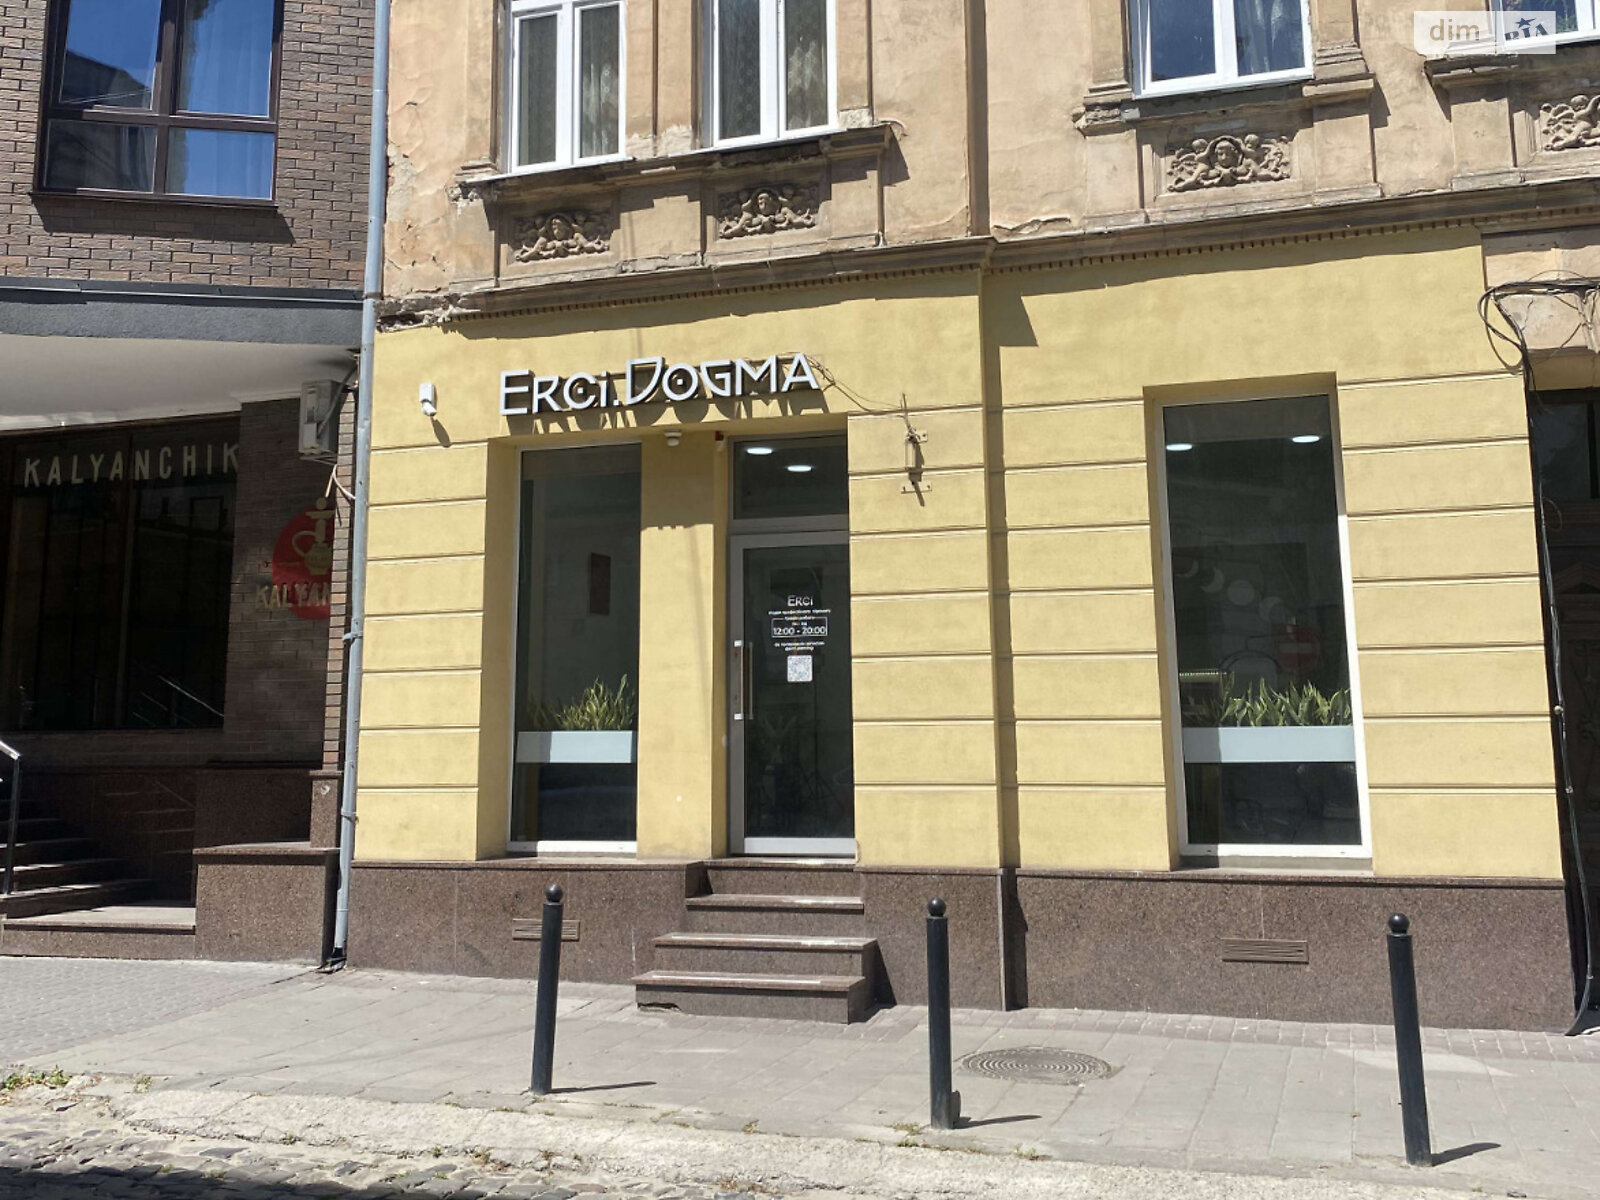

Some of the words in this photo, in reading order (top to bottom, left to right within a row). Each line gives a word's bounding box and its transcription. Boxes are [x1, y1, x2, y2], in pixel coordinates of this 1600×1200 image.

[23, 442, 239, 489] KALYANCHIK
[773, 627, 795, 635] 12:00
[802, 626, 826, 634] 20:00
